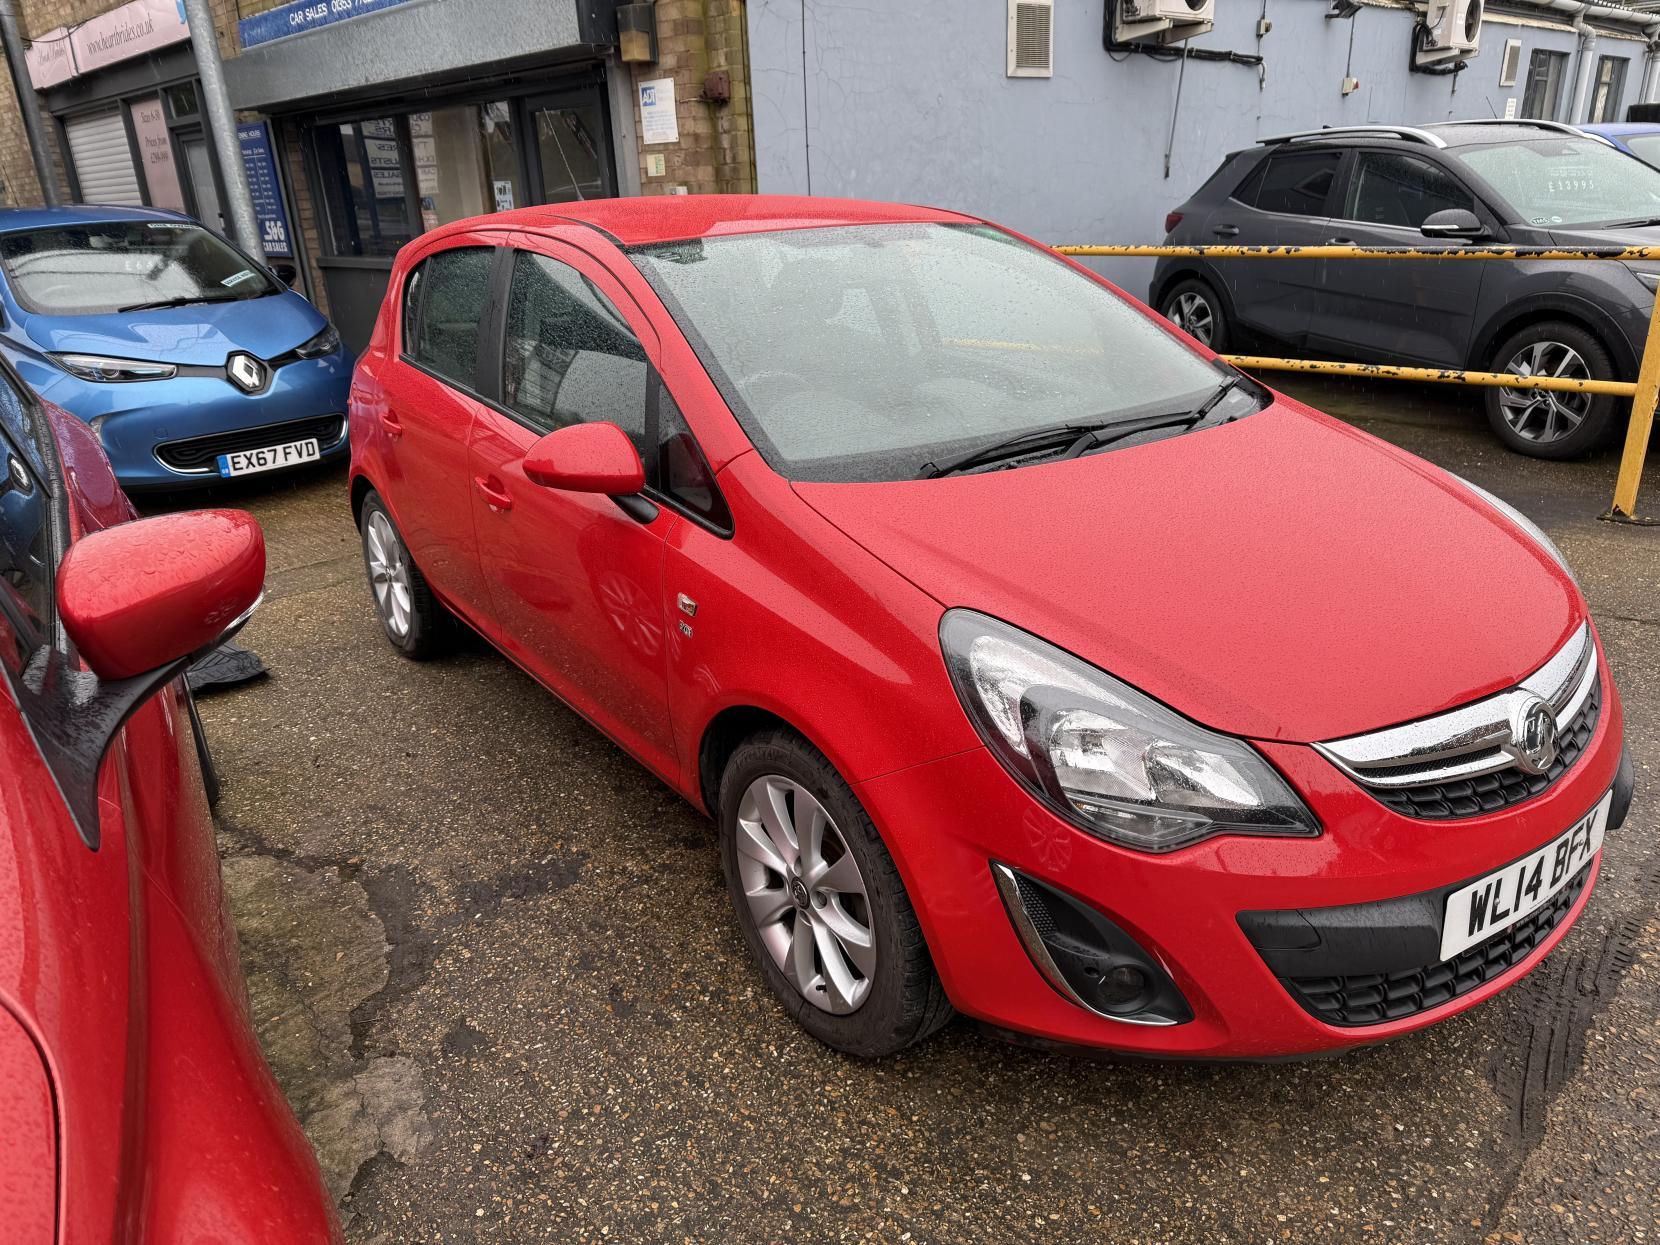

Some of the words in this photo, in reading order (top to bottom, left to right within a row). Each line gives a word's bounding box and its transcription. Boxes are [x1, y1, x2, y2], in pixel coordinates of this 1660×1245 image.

[289, 12, 304, 25] CAR
[306, 3, 328, 21] SALES
[86, 12, 154, 56] www.heartbrides.co.uk
[642, 88, 656, 102] ADT
[230, 448, 277, 471] EX67
[282, 441, 316, 461] FVD
[1467, 854, 1545, 938] WL14
[1549, 809, 1599, 889] BFX
